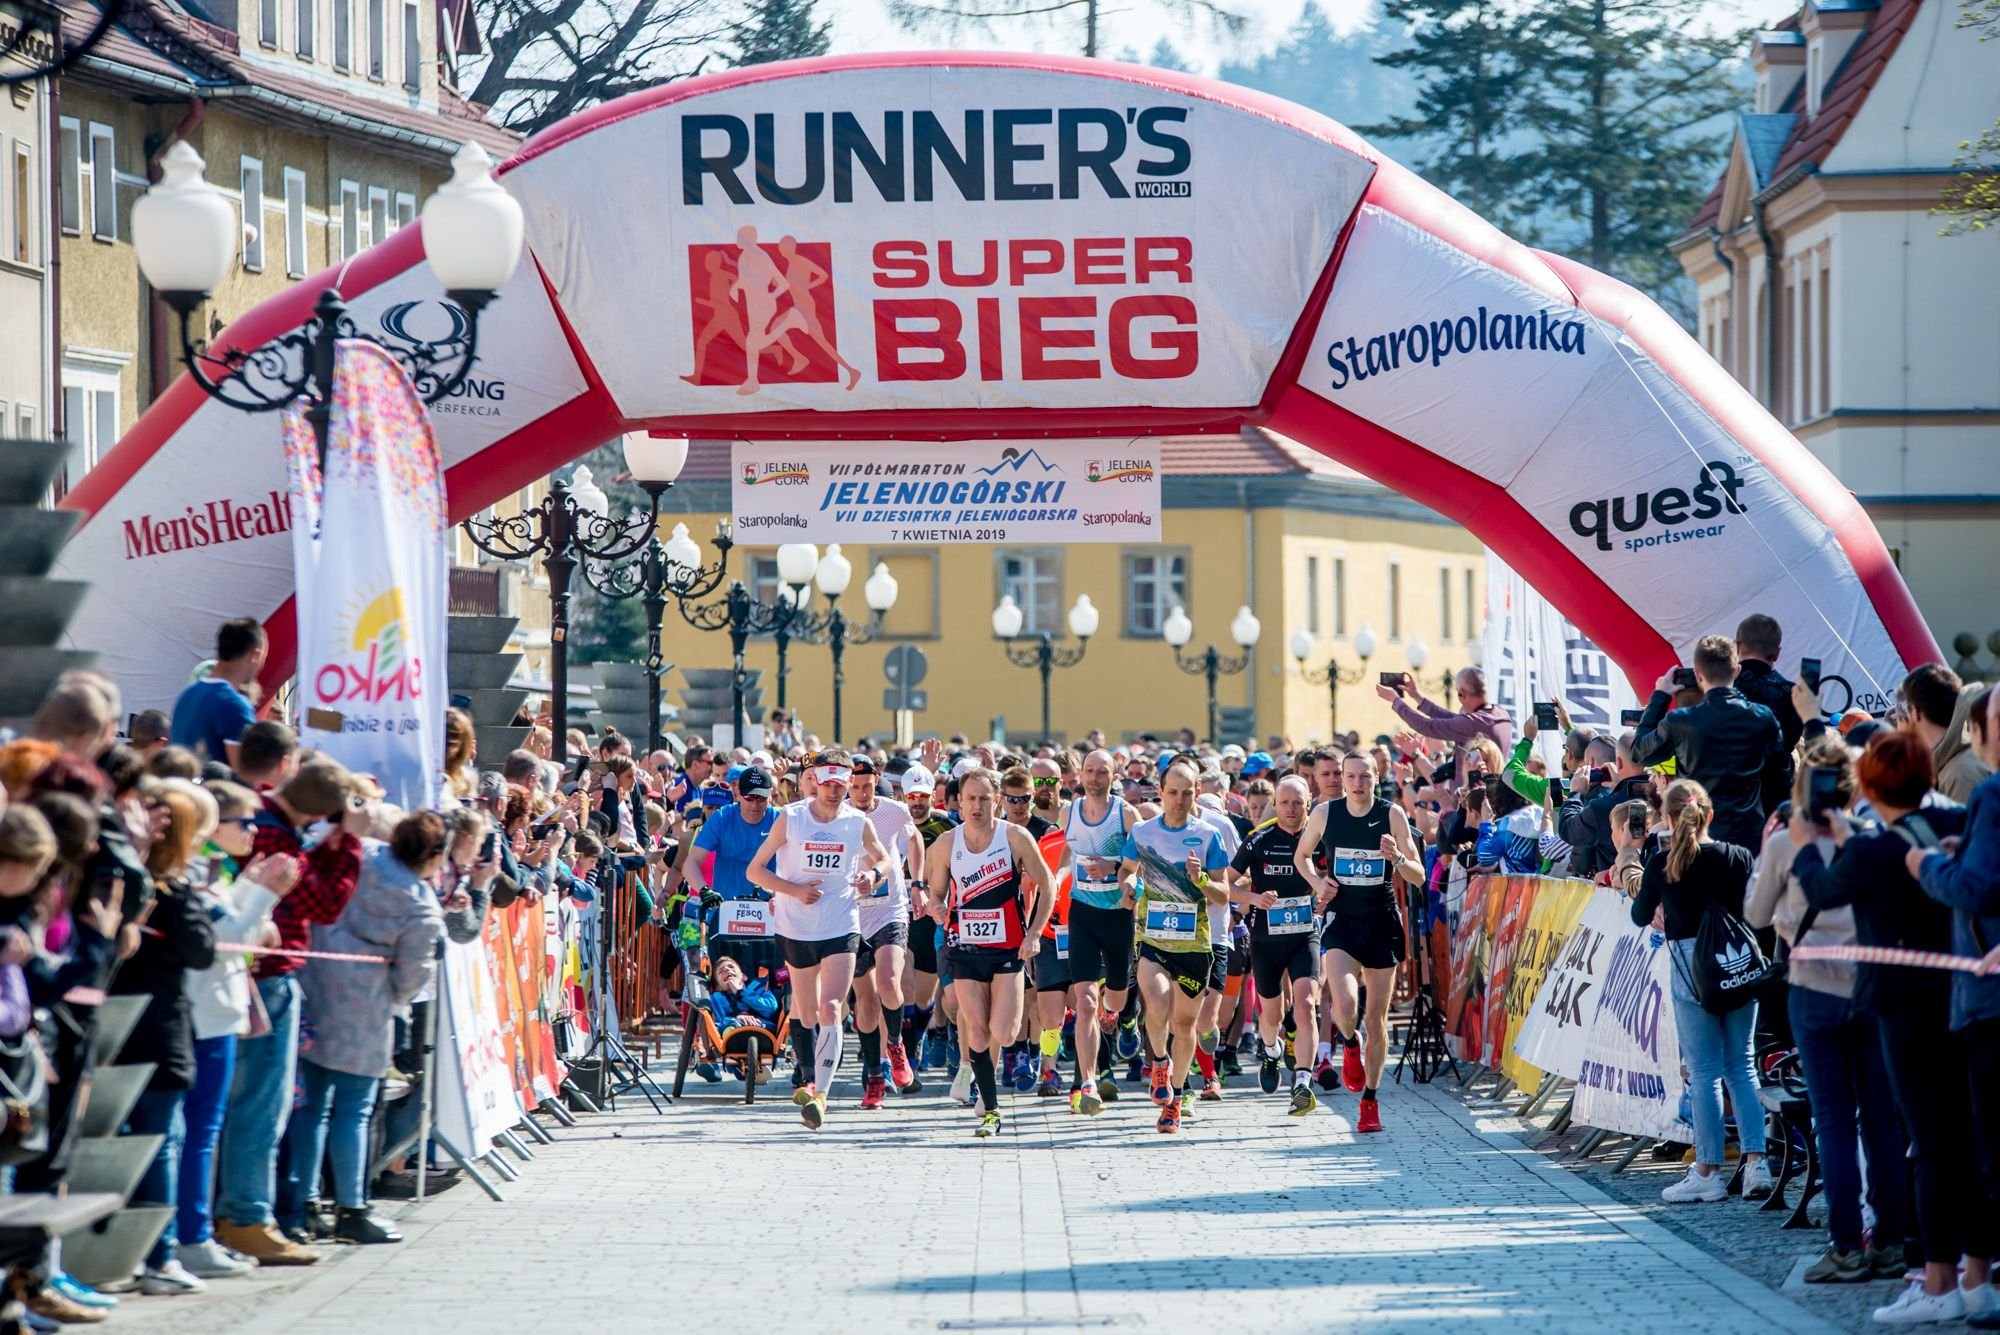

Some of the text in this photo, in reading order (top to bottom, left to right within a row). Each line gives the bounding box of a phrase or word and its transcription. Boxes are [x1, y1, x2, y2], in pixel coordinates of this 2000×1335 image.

[681, 106, 1192, 205] RUNNER'S
[1138, 182, 1190, 197] WORLD
[872, 236, 1193, 288] SUPER
[873, 295, 1199, 382] BIEG
[1327, 306, 1586, 390] Staropolanka
[764, 462, 809, 474] JELENIA
[829, 462, 966, 476] VII PÓŁMARATON
[1107, 459, 1153, 472] JELENIA
[819, 478, 1066, 511] JELENIOGÓRSKI
[1569, 461, 1749, 552] quest
[739, 513, 808, 528] Staropolanka
[835, 510, 859, 522] VII
[1082, 509, 1152, 526] Staropolanka
[891, 529, 1006, 541] 7 KWIETNIA 2019
[1624, 524, 1727, 552] sportswear
[807, 853, 841, 869] 1912
[1348, 862, 1372, 875] 149
[736, 909, 762, 921] FESCO
[1162, 916, 1179, 929] 48
[1284, 911, 1299, 923] 91
[964, 922, 998, 937] 1327
[1720, 967, 1762, 990] adidas
